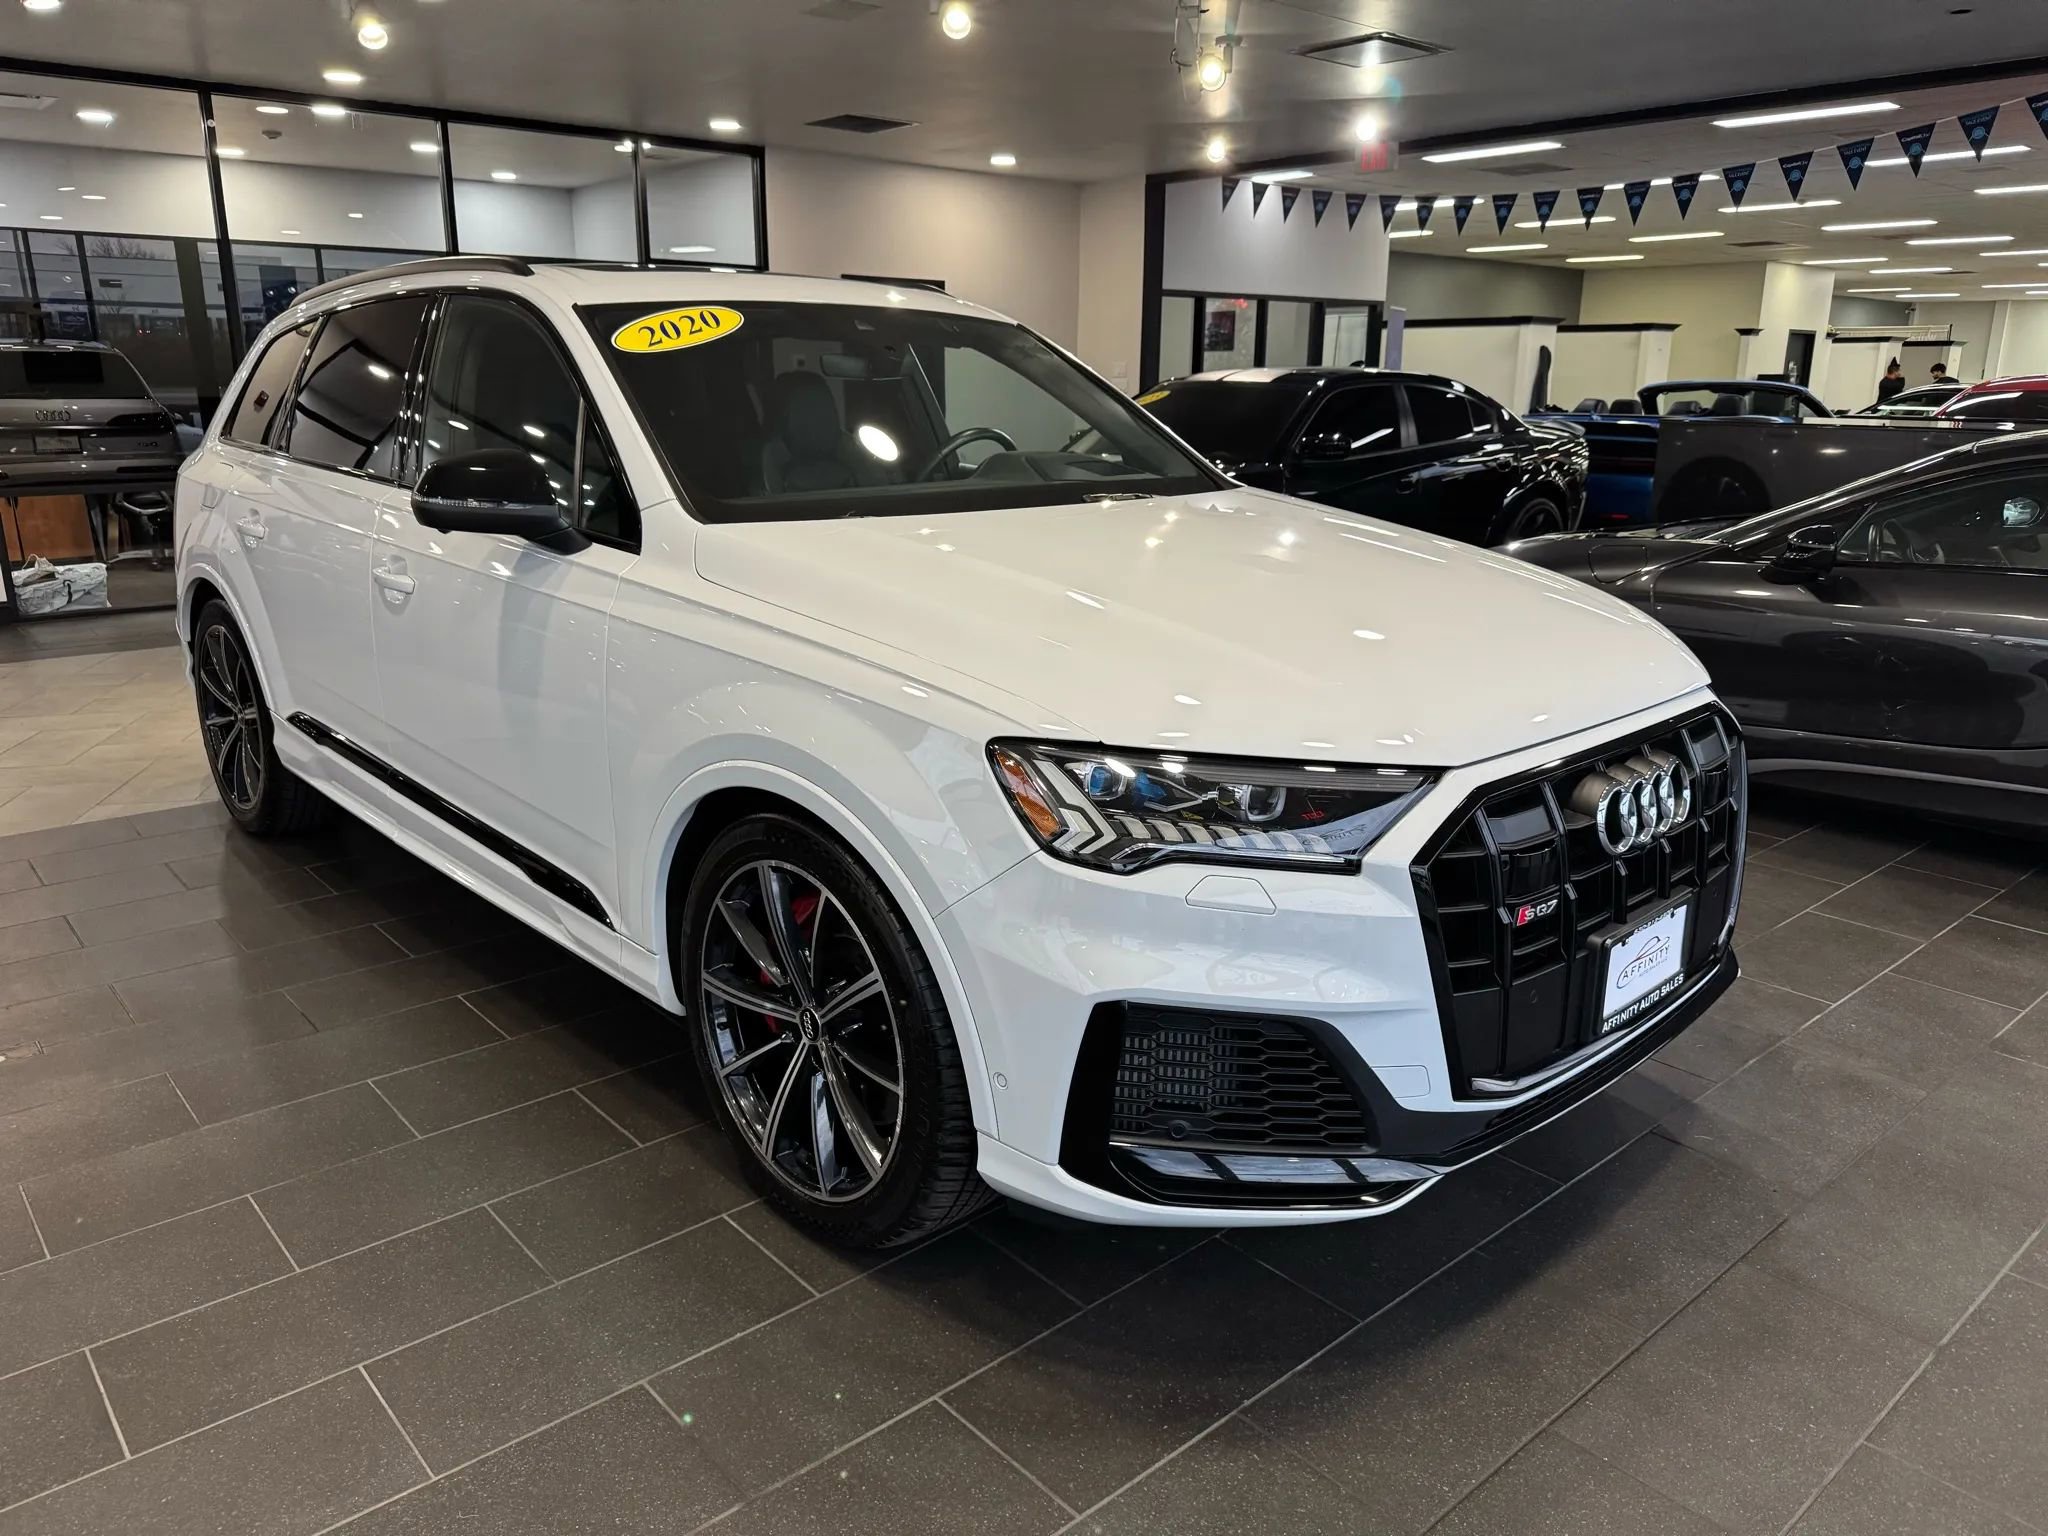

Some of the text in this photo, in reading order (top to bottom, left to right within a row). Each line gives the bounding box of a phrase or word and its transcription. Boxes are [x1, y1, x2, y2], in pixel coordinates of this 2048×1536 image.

[637, 309, 722, 348] 2020
[1522, 899, 1559, 922] SQ7
[1621, 944, 1670, 981] AFFINITY
[1601, 973, 1685, 1034] AFFINITY AUTO SALES
